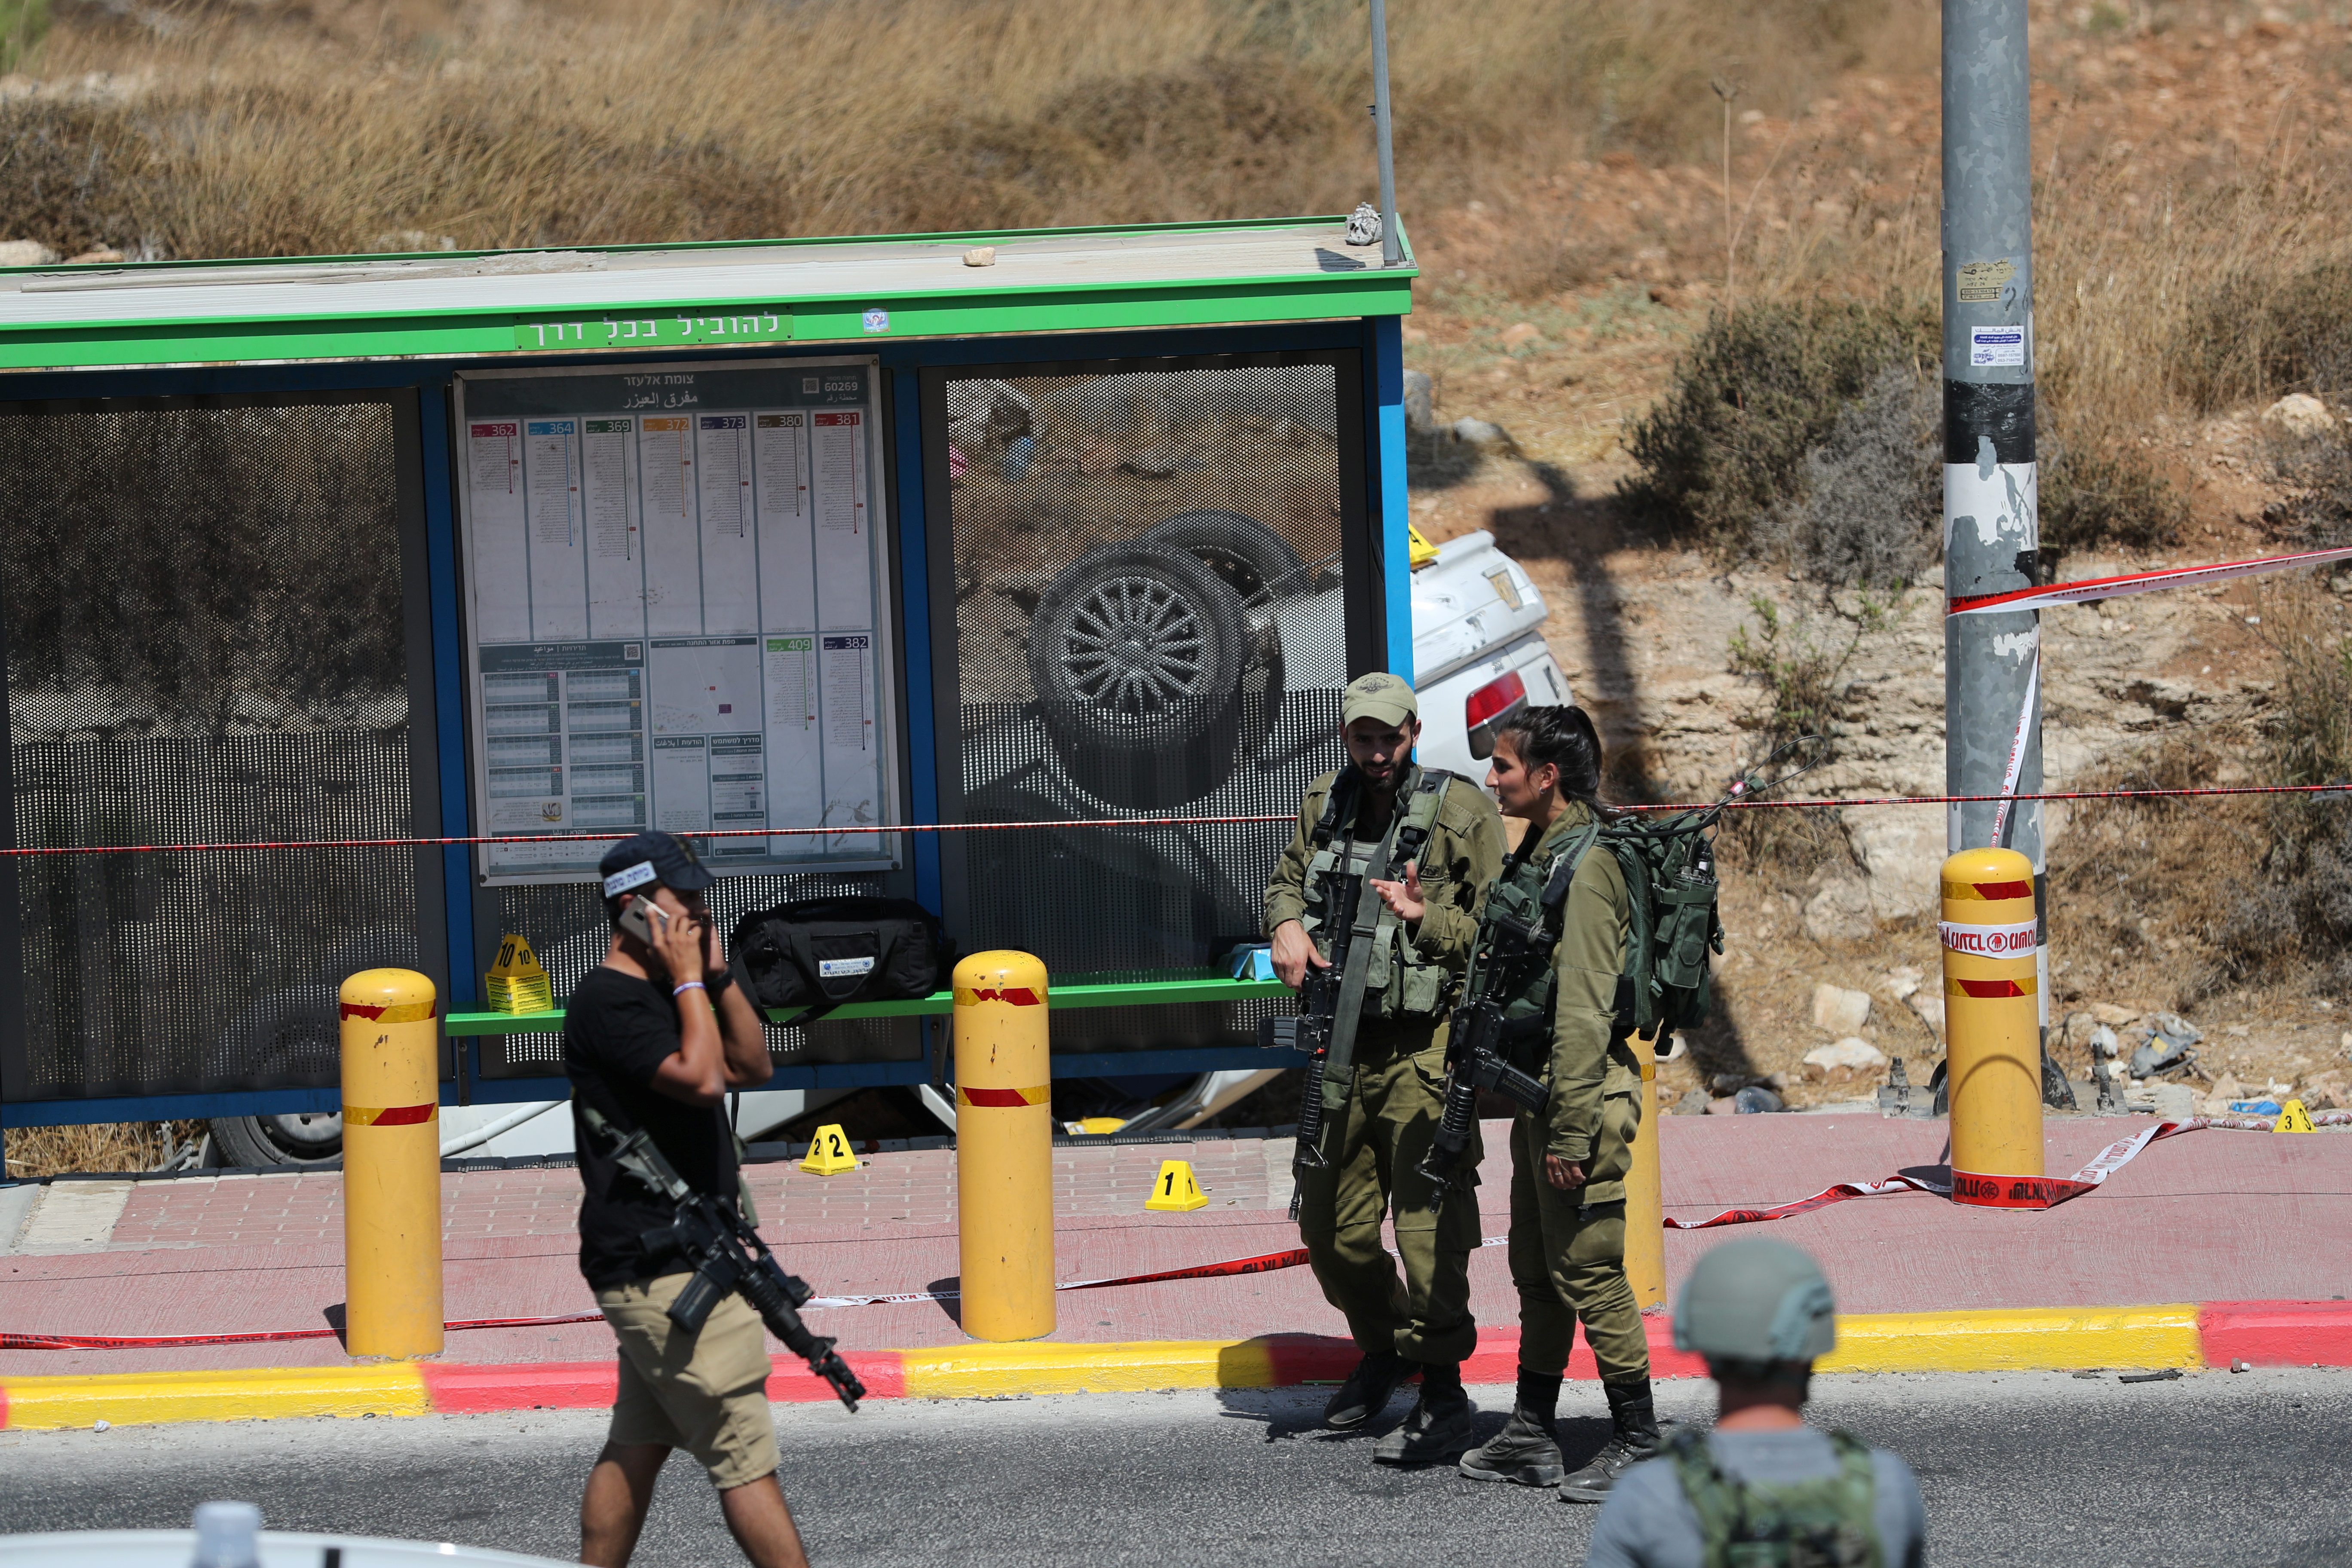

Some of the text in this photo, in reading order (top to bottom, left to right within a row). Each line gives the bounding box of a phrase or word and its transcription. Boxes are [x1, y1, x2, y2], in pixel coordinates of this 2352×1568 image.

[529, 311, 778, 346] להוביל בכל דרך
[624, 374, 694, 387] צומת אלעזר
[825, 382, 858, 392] 60269
[622, 390, 698, 409] مفرق إلعيزر
[827, 394, 838, 403] رقم
[607, 421, 630, 432] 369
[666, 420, 688, 430] 372
[723, 417, 744, 428] 373
[779, 416, 801, 426] 380
[836, 414, 857, 425] 381
[492, 425, 514, 436] 362
[550, 423, 572, 434] 364
[788, 639, 810, 650] 409
[845, 638, 867, 648] 382
[1951, 932, 1985, 951] מעבר
[2010, 929, 2036, 950] משטר
[498, 942, 515, 968] 10
[518, 949, 530, 965] 10
[2285, 1115, 2292, 1130] 3
[2299, 1108, 2312, 1131] 3
[814, 1138, 821, 1155] 2
[829, 1133, 845, 1157] 2
[1165, 1172, 1174, 1196] 1
[1188, 1177, 1193, 1194] 1
[1953, 1176, 1980, 1197] טרת
